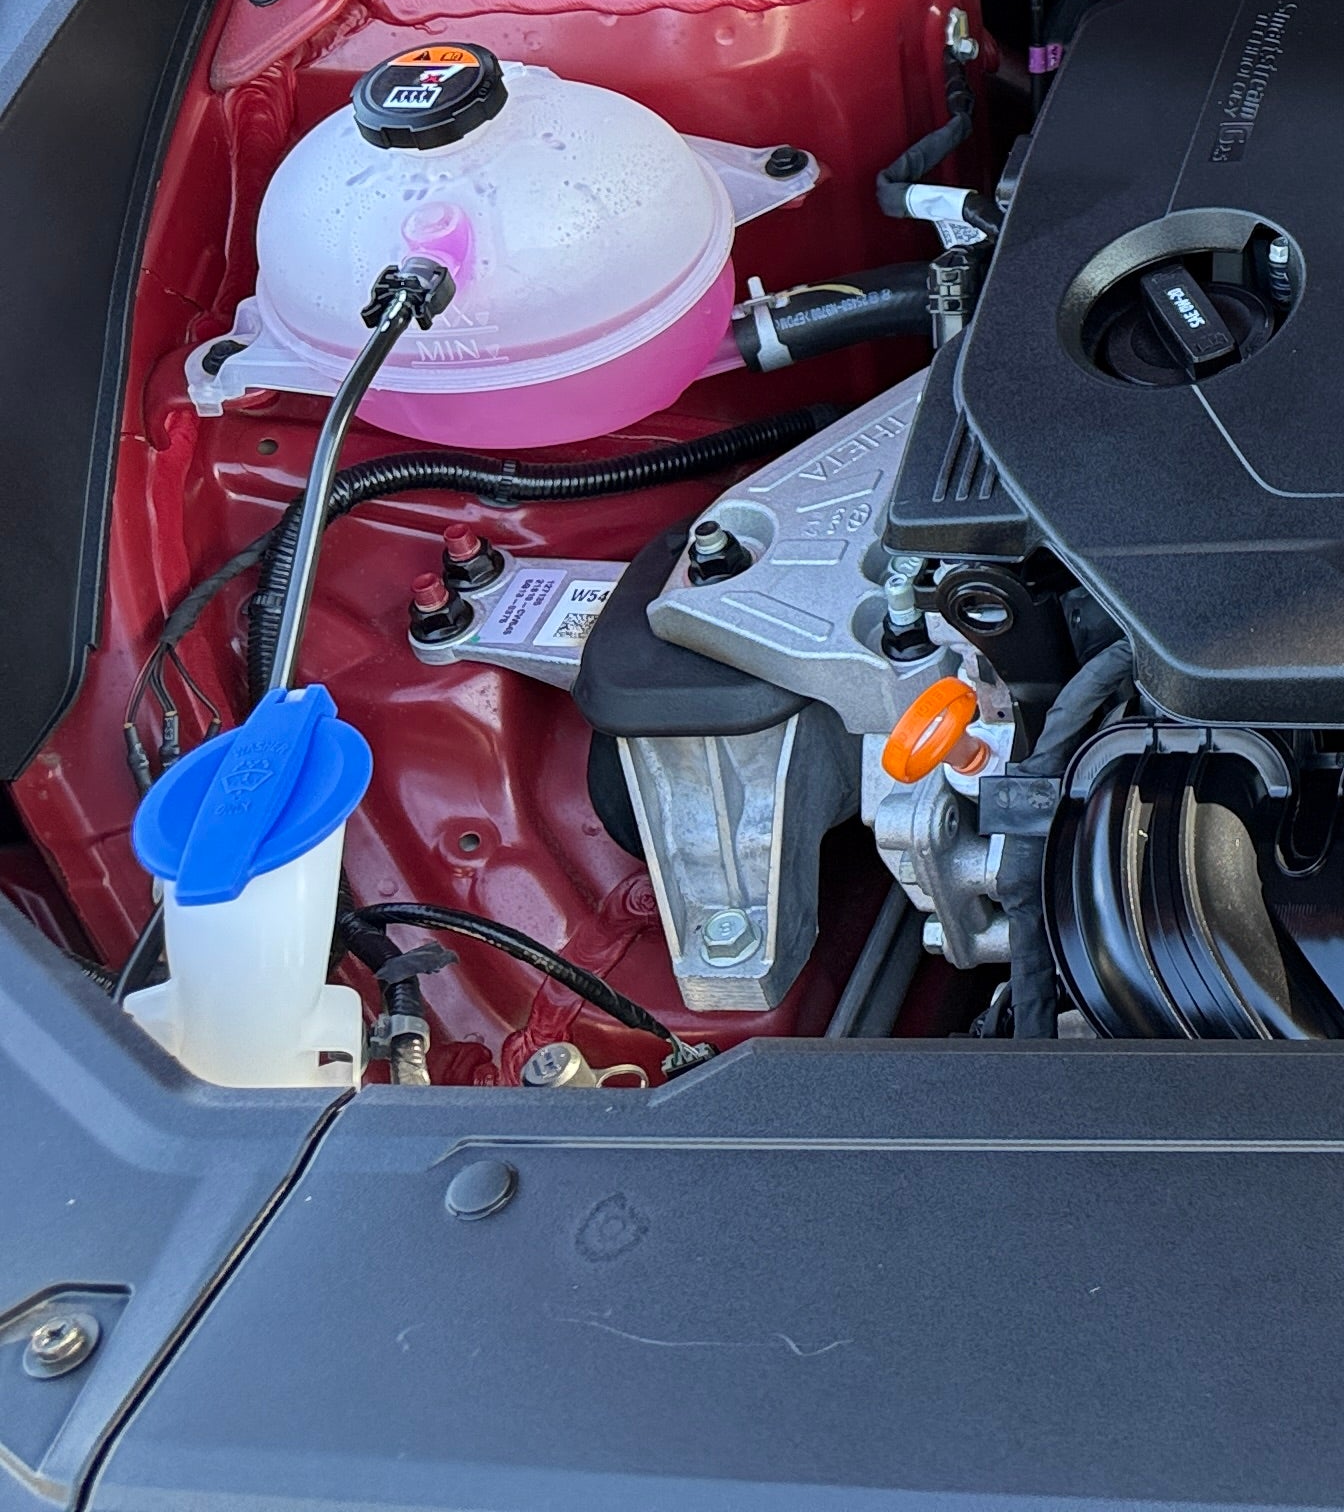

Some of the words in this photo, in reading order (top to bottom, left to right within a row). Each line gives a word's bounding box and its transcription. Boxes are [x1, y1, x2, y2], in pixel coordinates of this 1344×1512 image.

[1167, 287, 1195, 313] 0W-20
[1183, 309, 1206, 328] SAE
[415, 339, 480, 361] MIN
[799, 416, 909, 481] THETA
